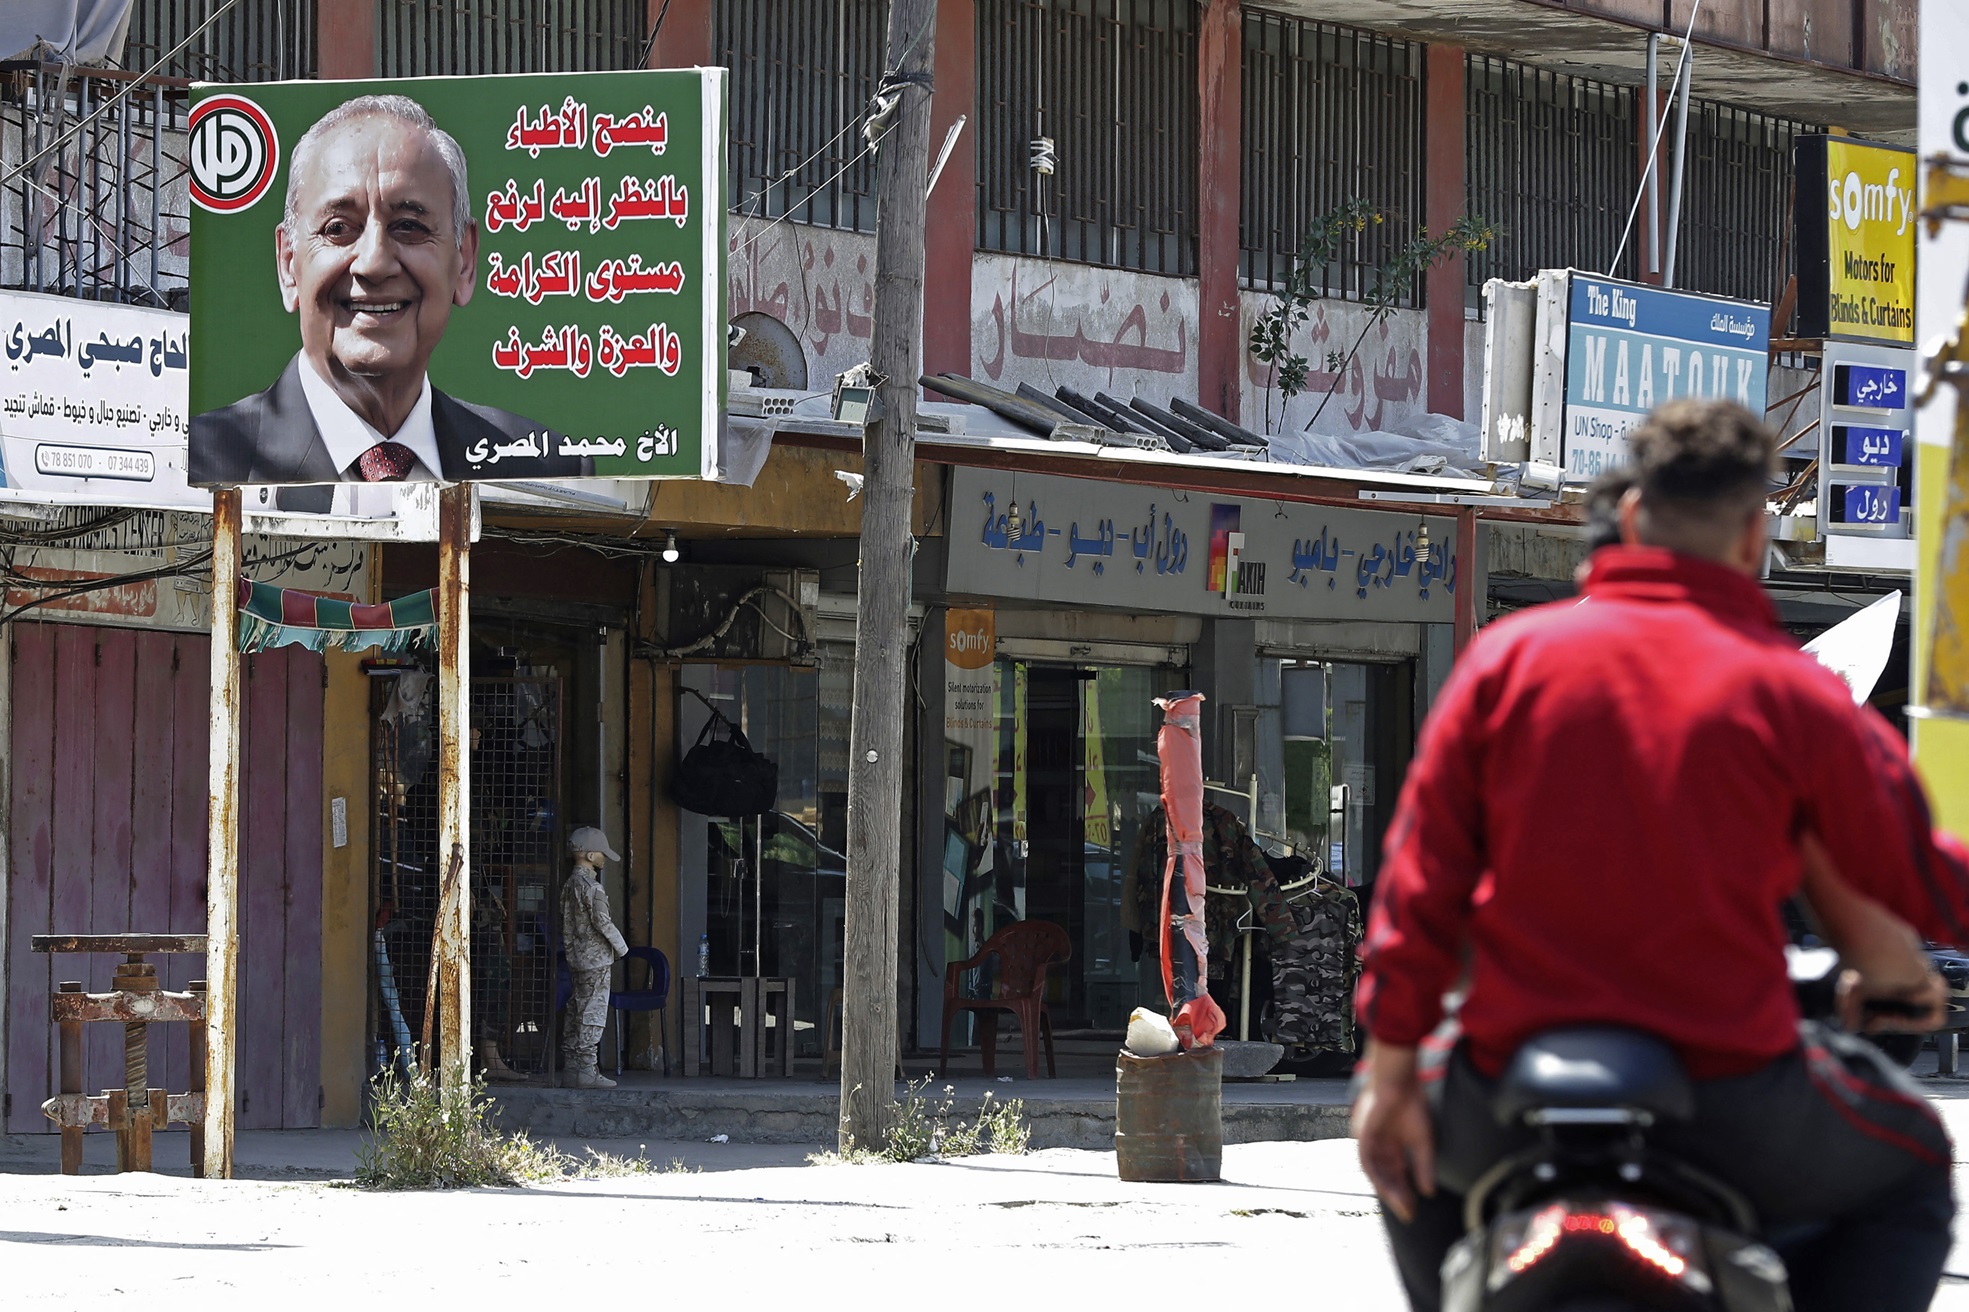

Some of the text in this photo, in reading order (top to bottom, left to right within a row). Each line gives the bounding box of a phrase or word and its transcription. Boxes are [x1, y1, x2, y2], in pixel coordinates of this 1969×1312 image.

[505, 96, 668, 159] ينصح الأطباء
[485, 174, 688, 235] بالنظر إليه لرفع
[1830, 168, 1911, 236] somfy
[487, 250, 685, 306] مستوى الكرامة
[1844, 250, 1895, 283] Motors for
[1587, 285, 1638, 328] The King
[1831, 293, 1912, 328] Blinds & Curtains
[1710, 313, 1728, 332] الملك
[5, 317, 188, 379] لحاج صبحي المصري
[492, 322, 682, 380] والعزة والشرف
[1582, 335, 1753, 409] MAATOUK
[1856, 373, 1898, 404] خارجي
[4, 394, 26, 418] تنجيد
[28, 391, 54, 418] قماش
[64, 397, 86, 424] خيوط
[89, 408, 94, 424] و
[97, 400, 114, 426] حبال
[117, 404, 141, 428] تصنيع
[150, 406, 172, 437] خارجي
[174, 416, 180, 432] و
[1575, 416, 1588, 436] UN
[1590, 416, 1612, 445] Shop
[466, 423, 678, 470] الأخ محمد المصري
[1858, 434, 1890, 464] ديو
[52, 452, 62, 466] 78
[63, 452, 76, 468] 851
[78, 454, 92, 469] 070
[108, 457, 118, 470] 07
[119, 458, 133, 472] 344
[134, 458, 148, 473] 439
[1572, 449, 1601, 476] 70-86
[1857, 490, 1888, 520] رول
[1064, 518, 1114, 576] ديو
[1133, 503, 1156, 575] أب
[1156, 512, 1188, 576] رول
[1287, 526, 1338, 592] بامبو
[1357, 530, 1415, 600] خارجي
[950, 628, 989, 654] somfy
[948, 681, 992, 694] Silent motorization
[955, 698, 977, 710] solutions
[946, 717, 964, 728] Blinds
[969, 718, 992, 730] Curtains
